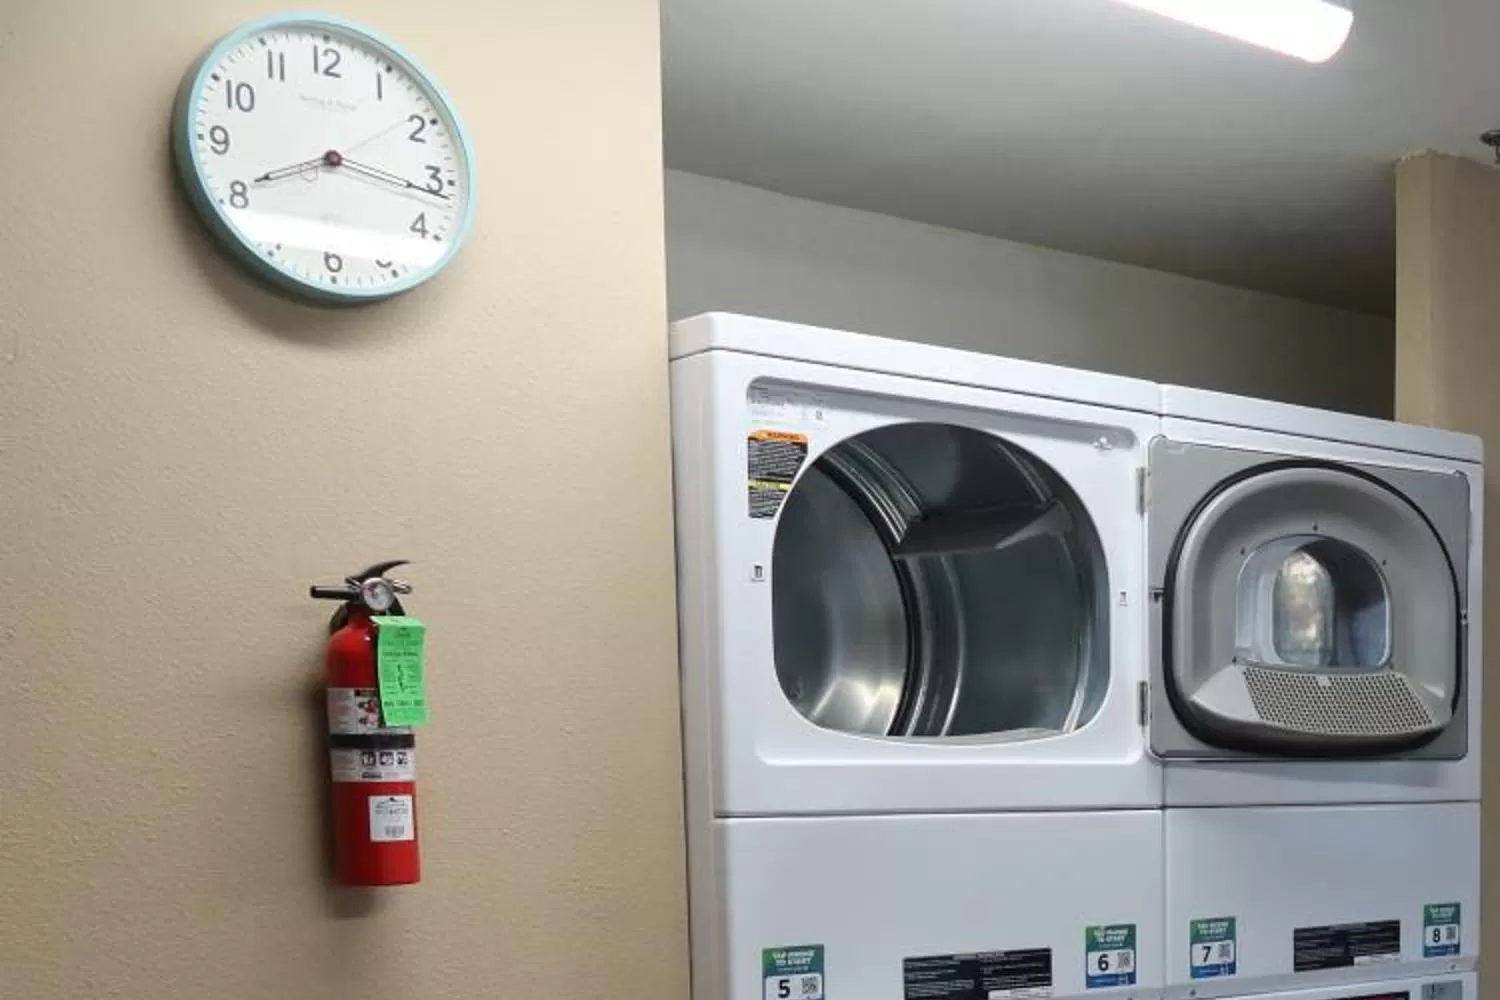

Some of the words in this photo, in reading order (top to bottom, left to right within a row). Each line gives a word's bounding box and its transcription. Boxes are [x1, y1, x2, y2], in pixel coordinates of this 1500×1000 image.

[266, 49, 285, 81] 11
[313, 44, 342, 79] 12
[225, 79, 255, 112] 10
[376, 72, 383, 101] 1
[209, 125, 230, 155] 9
[407, 114, 427, 144] 2
[424, 165, 444, 194] 3
[229, 180, 249, 210] 8
[409, 212, 429, 239] 4
[323, 252, 343, 273] 6
[1432, 927, 1441, 943] 8
[1097, 953, 1109, 971] 6
[1201, 945, 1212, 962] 7
[778, 979, 791, 998] 5
